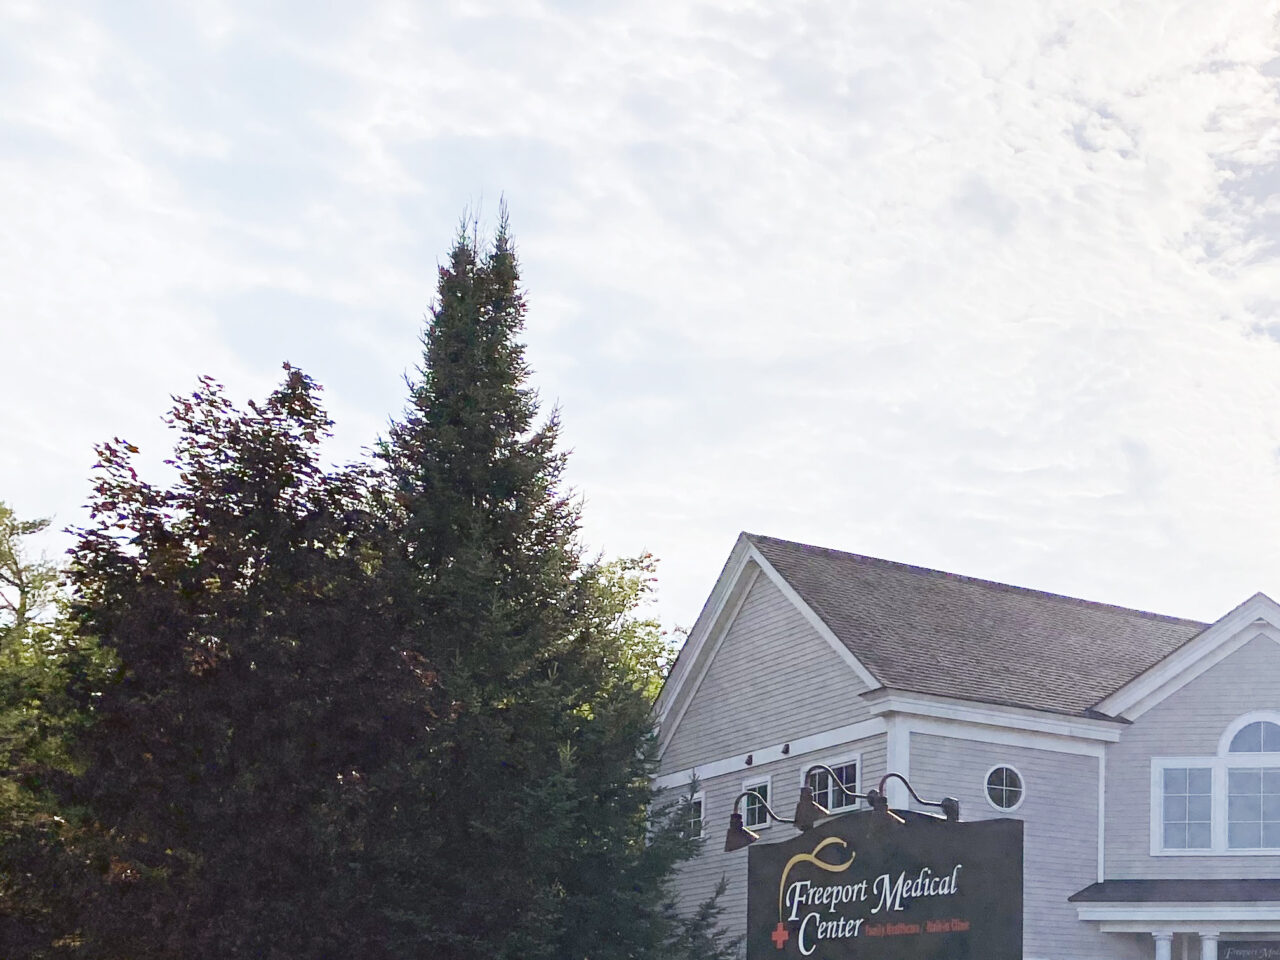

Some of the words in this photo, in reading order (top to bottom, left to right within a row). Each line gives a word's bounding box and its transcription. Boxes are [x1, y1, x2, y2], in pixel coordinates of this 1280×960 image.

[786, 880, 868, 921] Freeport
[871, 864, 962, 914] Medical
[799, 912, 864, 956] Center
